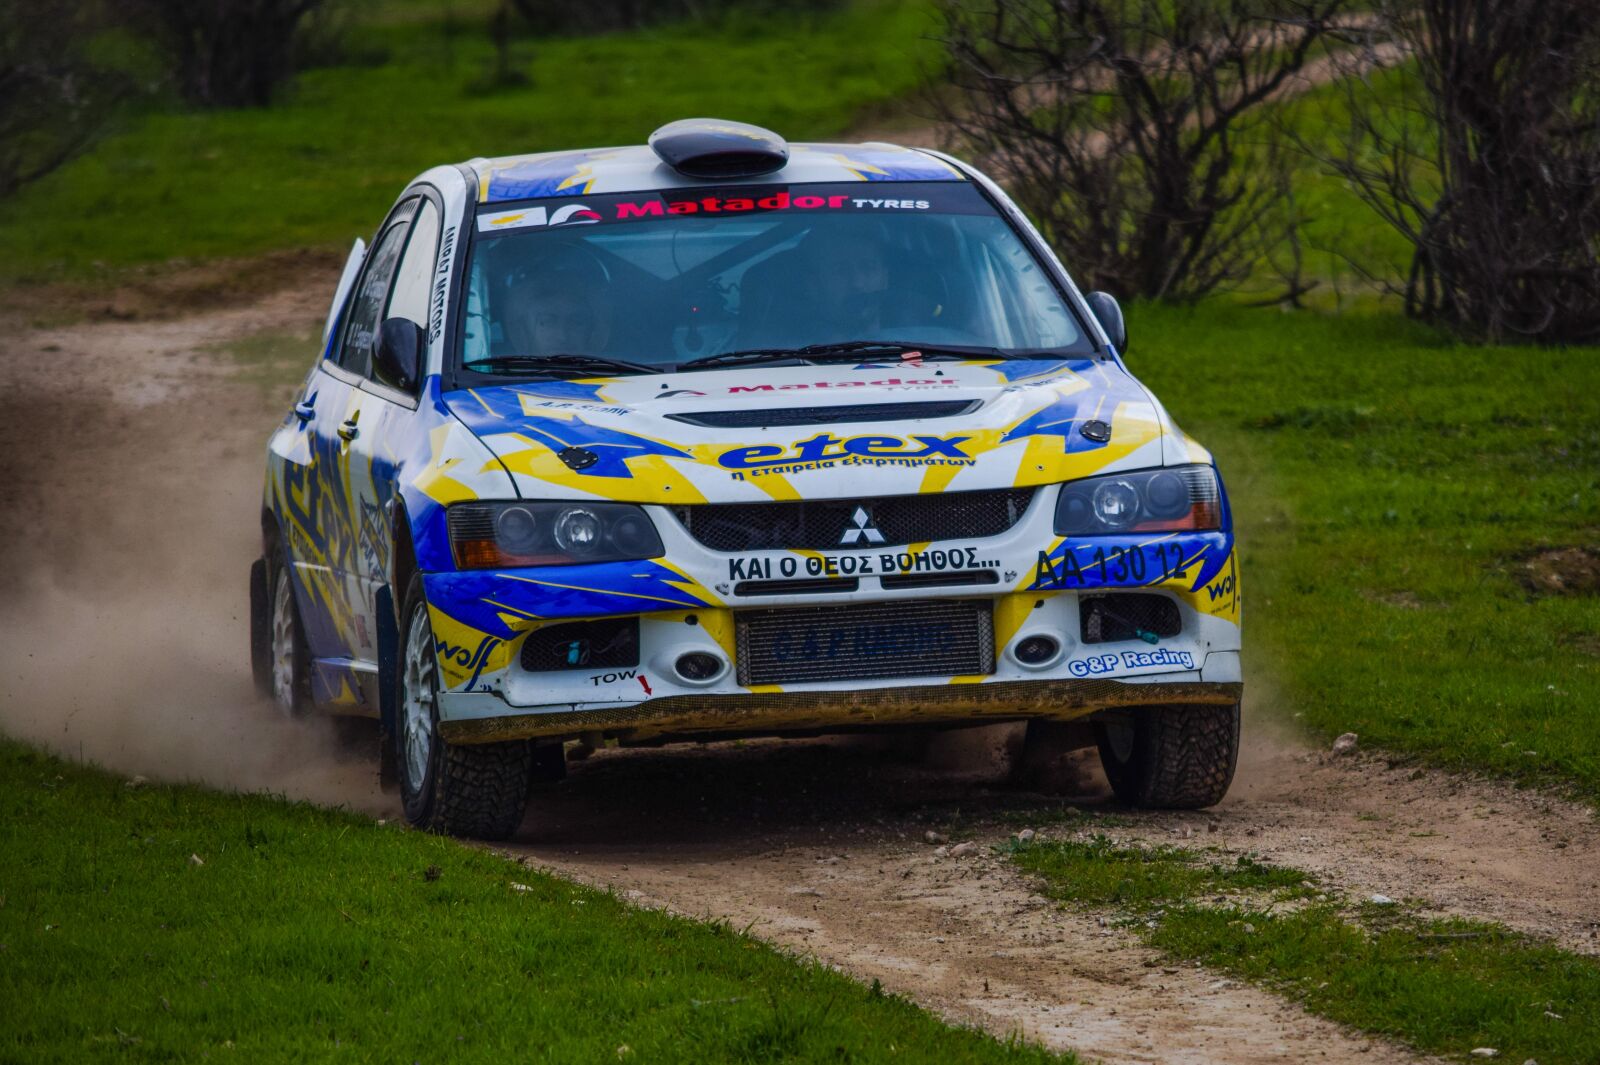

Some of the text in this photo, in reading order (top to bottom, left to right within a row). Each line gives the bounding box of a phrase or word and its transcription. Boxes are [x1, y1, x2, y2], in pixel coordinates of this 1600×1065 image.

[616, 192, 930, 219] Matador TYRES
[429, 277, 448, 345] MOTORS
[728, 378, 960, 394] Matador
[718, 434, 972, 469] etex
[731, 456, 977, 481] η εταιρεία εξαρτημάτων
[729, 558, 771, 580] ΚΑΙ
[780, 557, 797, 577] Ο
[805, 556, 873, 576] ΘΕΟΣ
[1034, 542, 1186, 588] AA 130 12
[434, 634, 503, 691] wolf
[1069, 648, 1195, 677] G&P Racing
[590, 670, 637, 686] TOW
